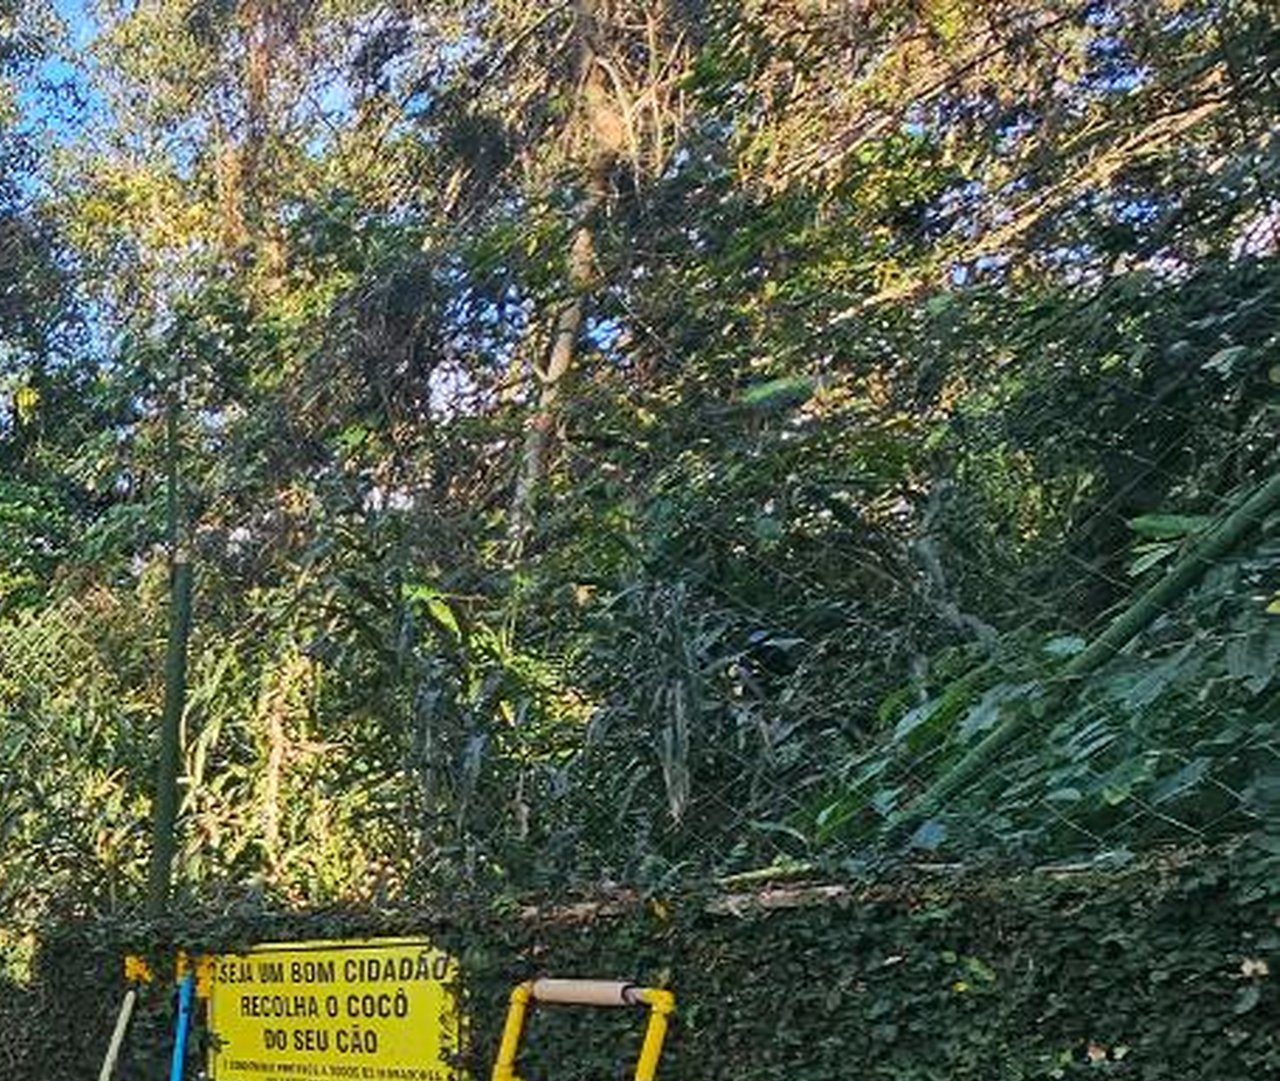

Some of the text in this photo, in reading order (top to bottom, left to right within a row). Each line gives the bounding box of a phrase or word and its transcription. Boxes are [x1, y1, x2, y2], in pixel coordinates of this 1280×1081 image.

[218, 955, 449, 983] SEJA UM BOM CIDADÃO
[241, 988, 408, 1018] RECOLHA O COCÔ
[264, 1025, 378, 1053] DO SEU CÃO
